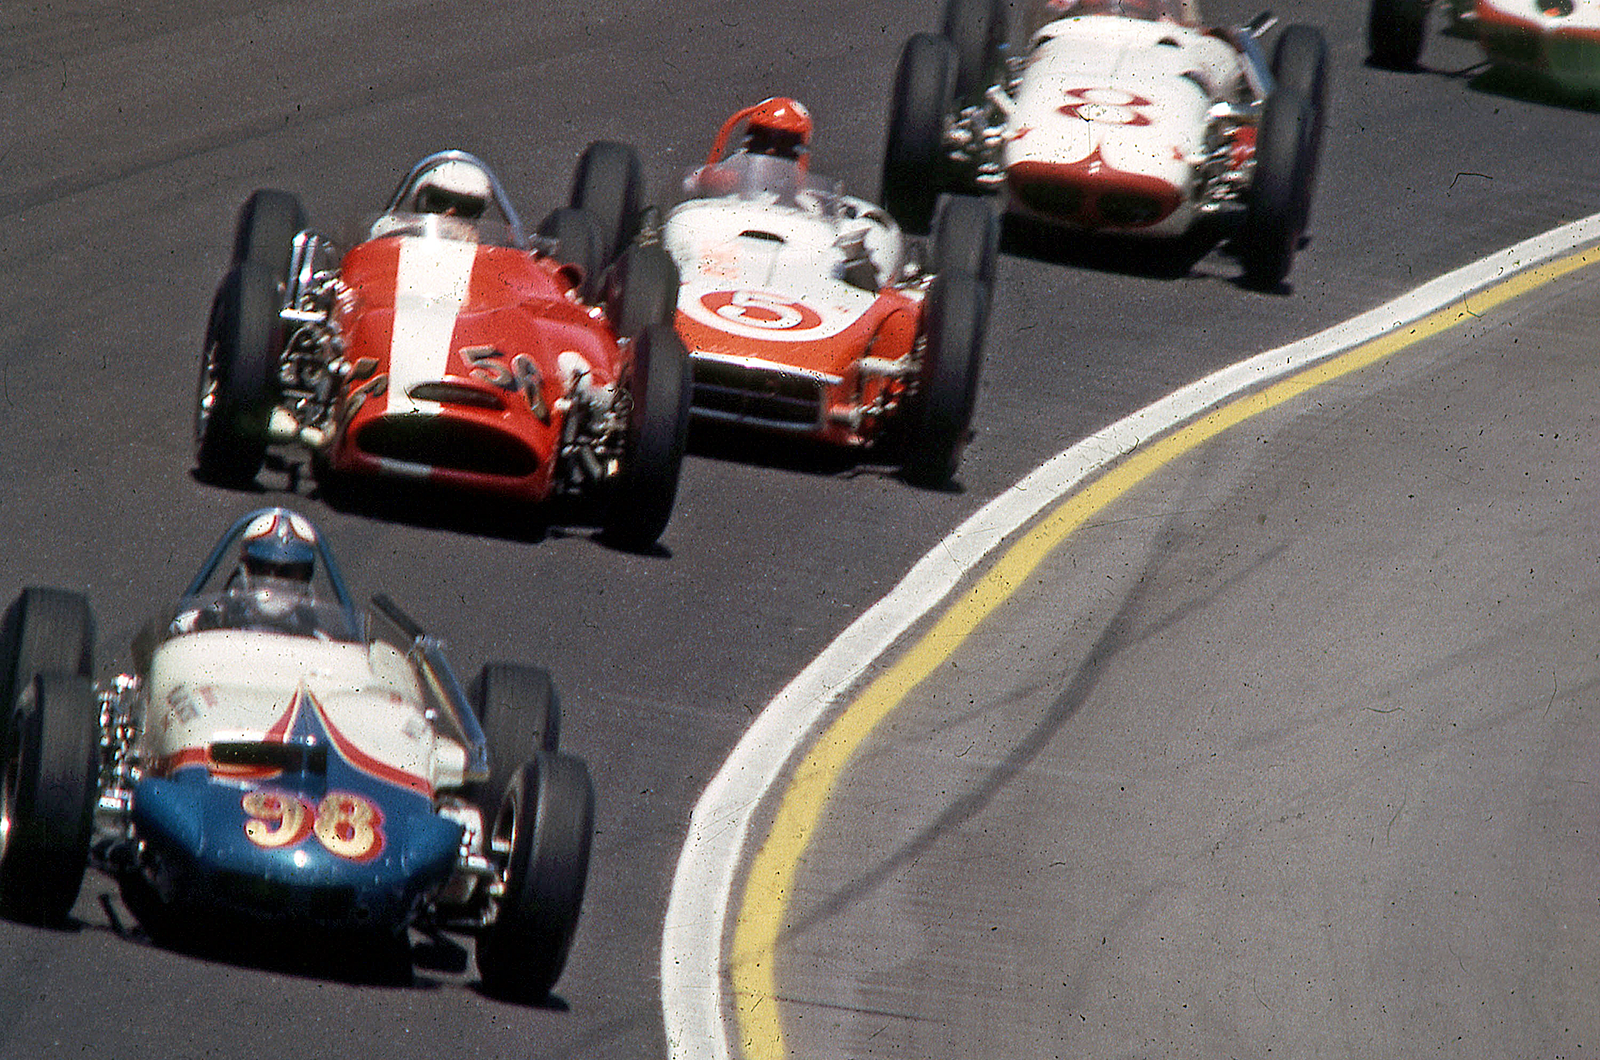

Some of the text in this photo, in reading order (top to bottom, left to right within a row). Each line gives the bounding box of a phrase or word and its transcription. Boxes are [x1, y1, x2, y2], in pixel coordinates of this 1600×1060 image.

[1055, 87, 1153, 126] 8
[717, 290, 803, 329] 5
[241, 787, 386, 863] 98
